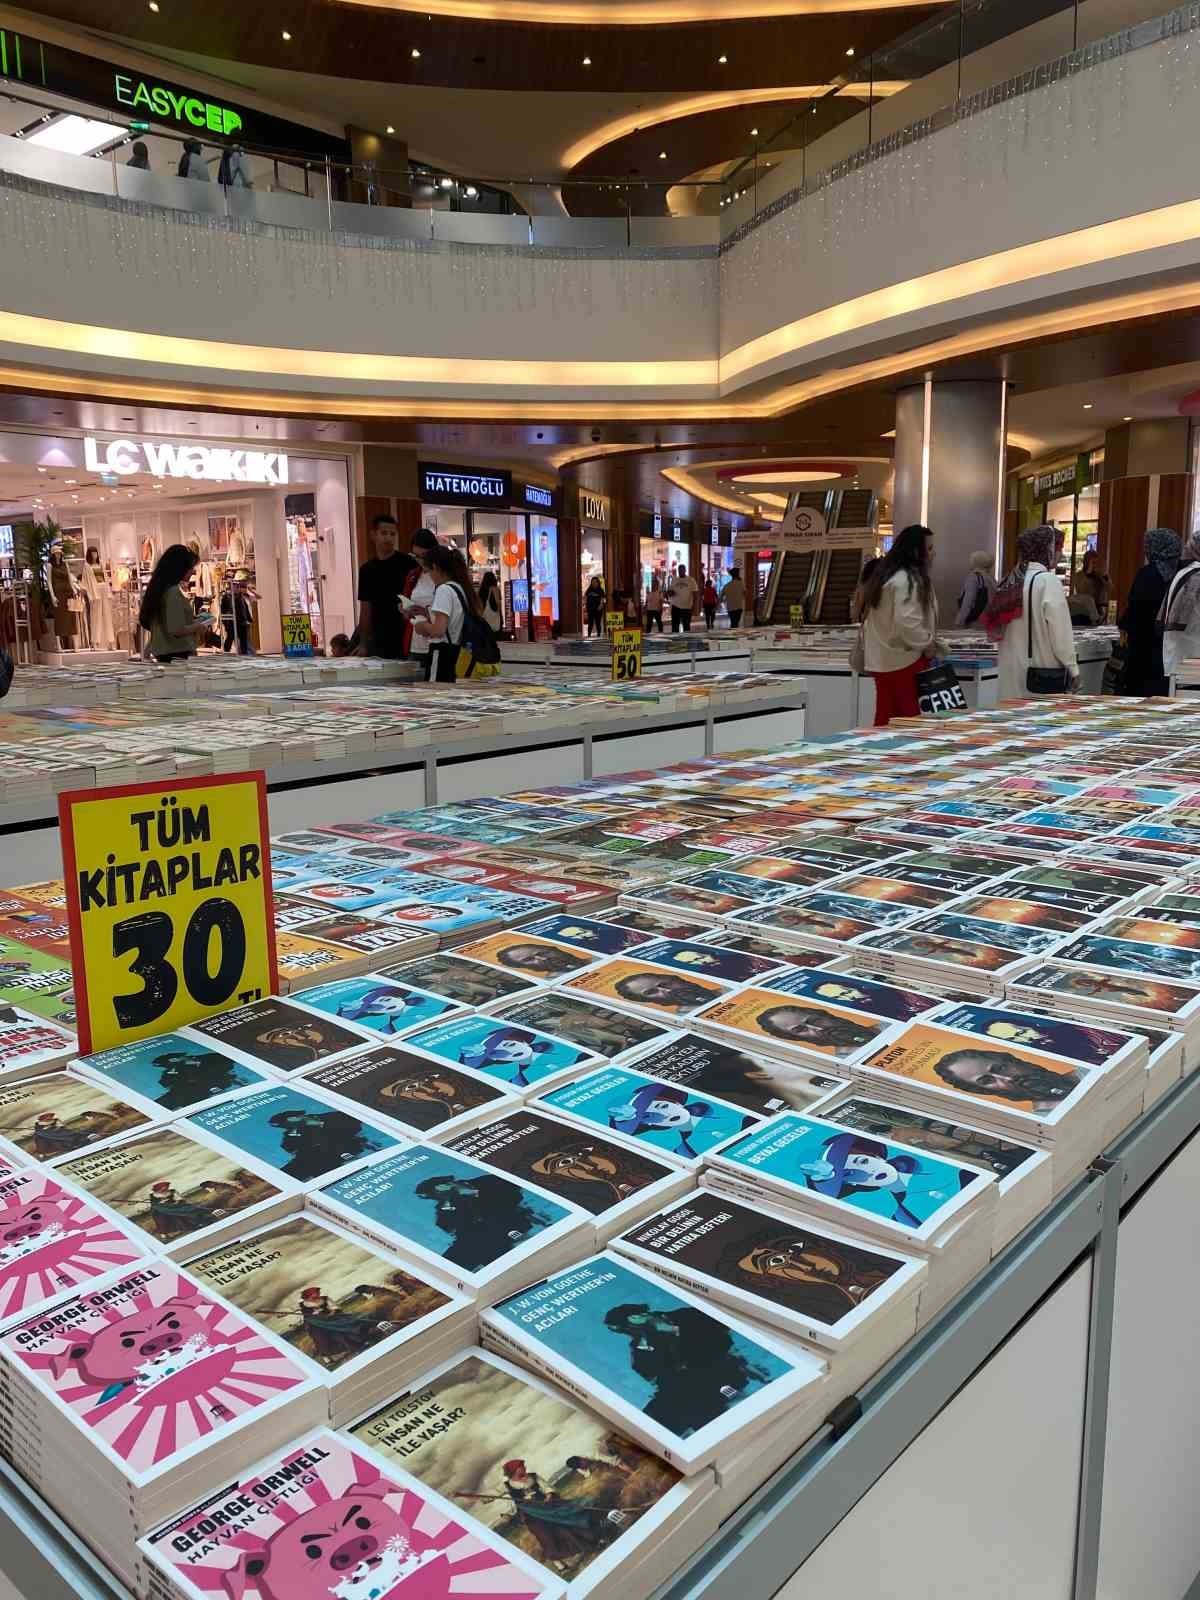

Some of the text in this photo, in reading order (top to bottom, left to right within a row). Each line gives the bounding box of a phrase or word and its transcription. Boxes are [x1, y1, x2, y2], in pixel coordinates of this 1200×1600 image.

[115, 74, 242, 135] EASYCEP
[84, 437, 140, 475] LC
[426, 475, 504, 496] HATEMOĞLU
[289, 631, 306, 643] 70
[617, 654, 637, 680] 50
[130, 796, 211, 851] TÜM
[79, 844, 262, 912] KİTAPLAR
[112, 897, 247, 1029] 30
[874, 1046, 907, 1069] PLATON
[353, 1171, 376, 1183] VON
[355, 1182, 394, 1206] ACILARI
[649, 1215, 704, 1248] BİR DELİNİN
[664, 1210, 734, 1254] HATIRA DEFTERİ
[667, 1208, 695, 1224] GOGOL
[196, 1239, 261, 1272] LEV TOLSTOY
[246, 1248, 265, 1260] NE
[530, 1288, 556, 1302] VON
[553, 1269, 595, 1291] GOETHE
[15, 1269, 161, 1345] GEORGE ORWELL
[521, 1303, 554, 1323] GENÇ
[534, 1305, 579, 1333] ACILARI
[26, 1317, 88, 1352] HAYVAN
[367, 1389, 437, 1437] LEV TOLSTOY
[377, 1403, 444, 1448] İNSAN NE
[392, 1407, 467, 1457] İLE YAŞAR?
[171, 1493, 256, 1552] GEORGE
[251, 1447, 331, 1498] ORWELL
[187, 1514, 256, 1563] HAYVAN
